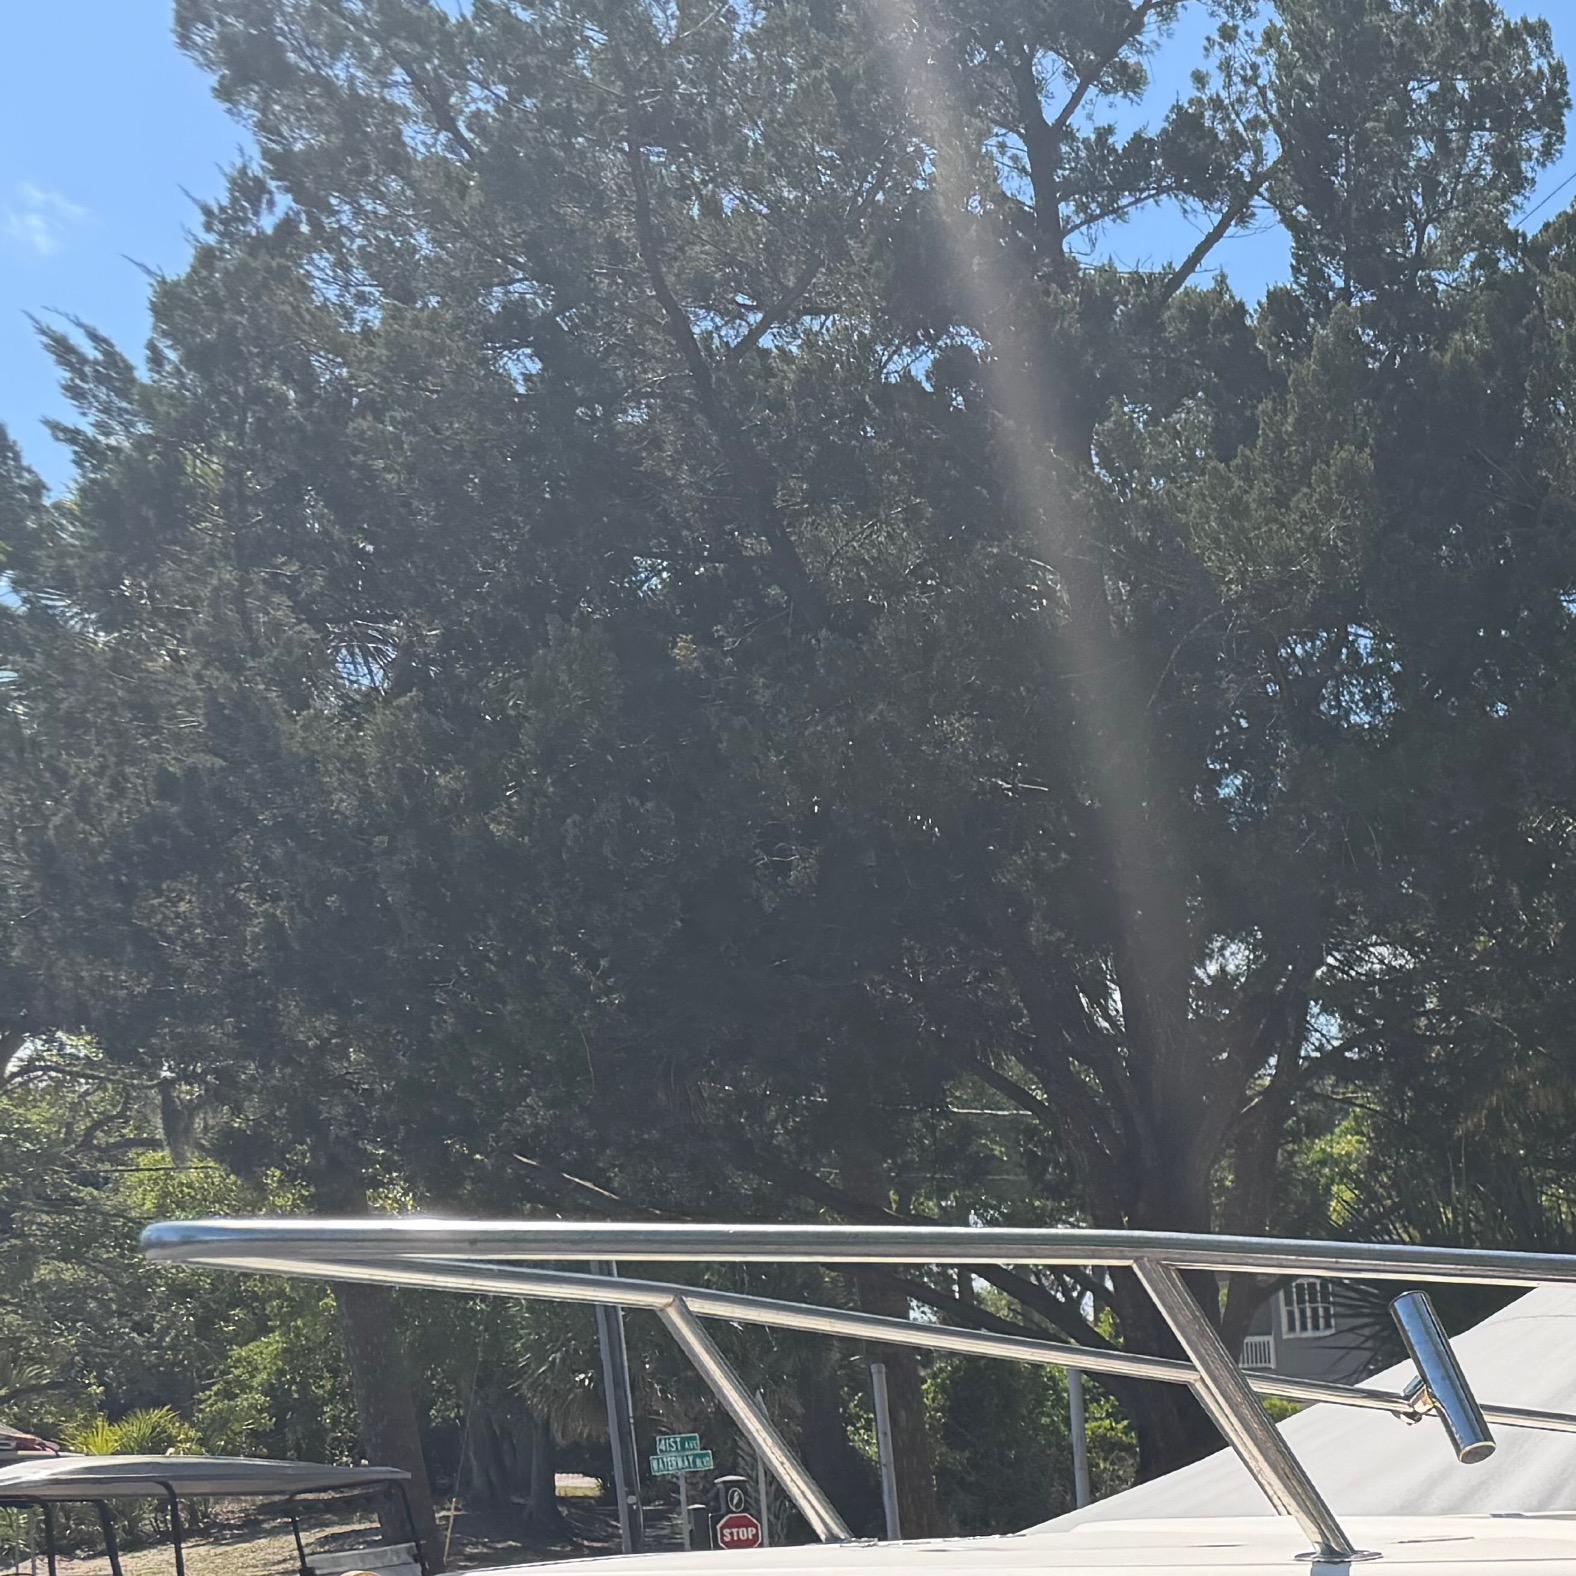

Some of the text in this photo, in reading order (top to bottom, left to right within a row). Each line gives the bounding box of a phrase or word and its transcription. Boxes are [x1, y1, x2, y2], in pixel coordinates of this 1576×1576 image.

[659, 1437, 698, 1452] 41ST AVE
[652, 1455, 694, 1471] WATERWAY
[723, 1526, 757, 1542] STOP
